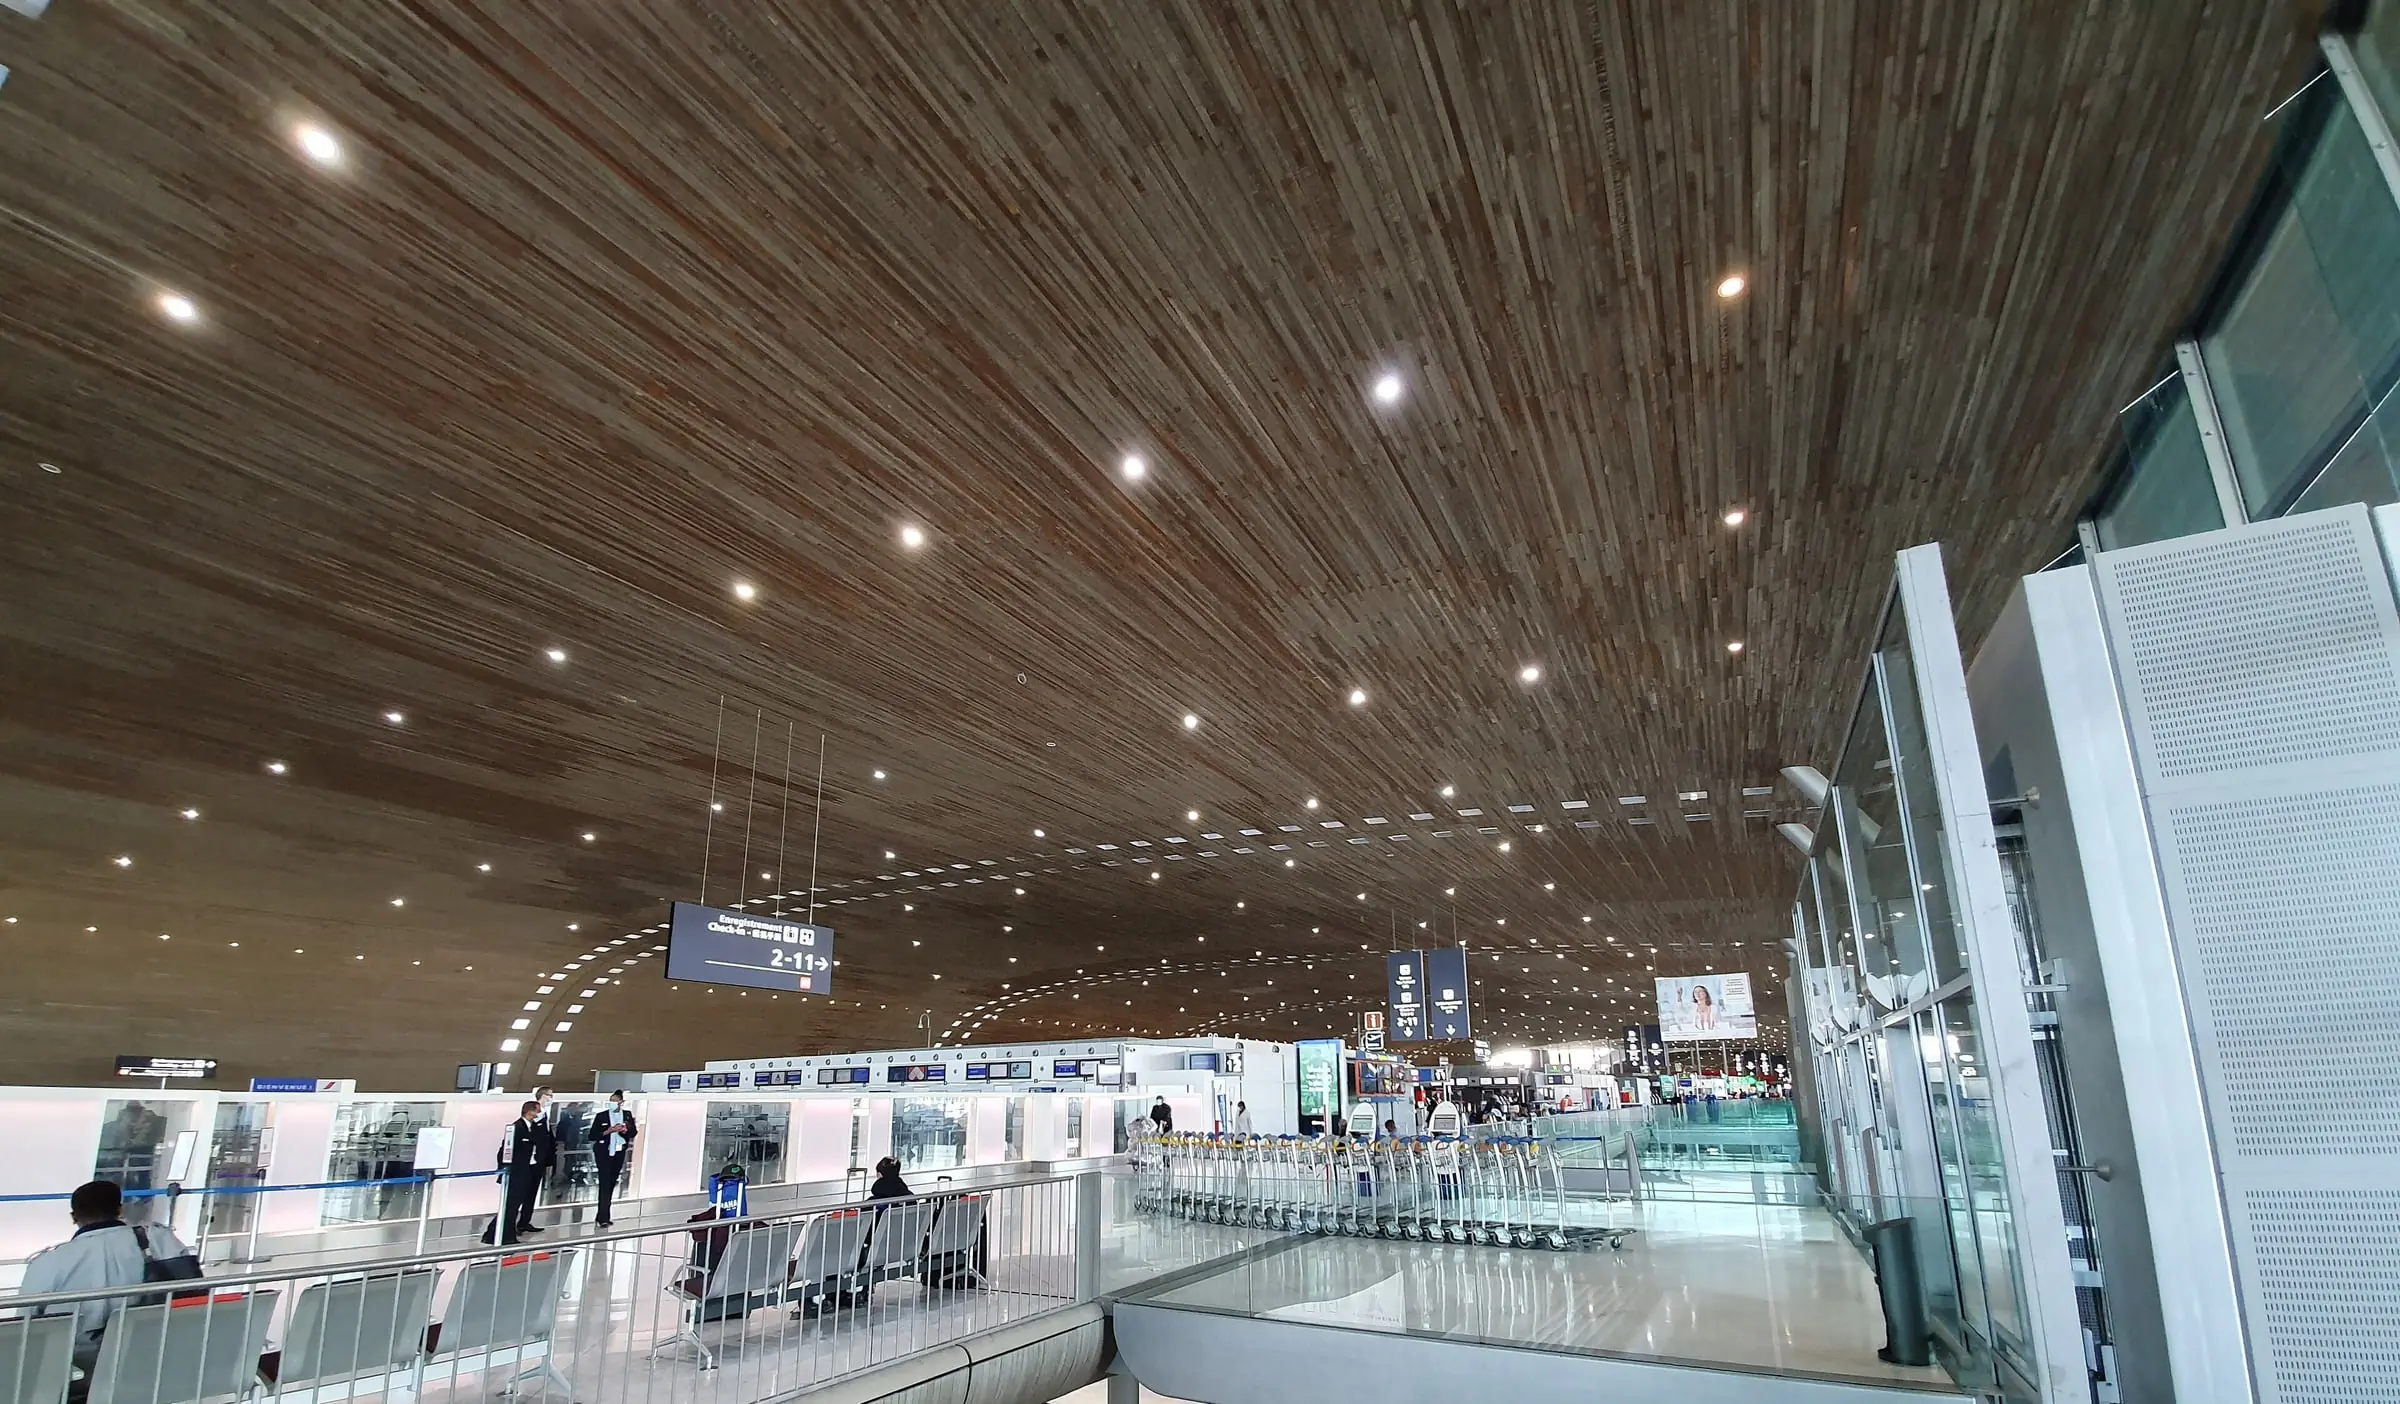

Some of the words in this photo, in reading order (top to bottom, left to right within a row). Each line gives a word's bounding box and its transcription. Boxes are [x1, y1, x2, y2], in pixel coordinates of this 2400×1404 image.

[707, 921, 746, 936] Check-in
[719, 914, 783, 933] Enregistrement
[770, 948, 814, 971] 2-11
[1227, 1059, 1242, 1072] 12
